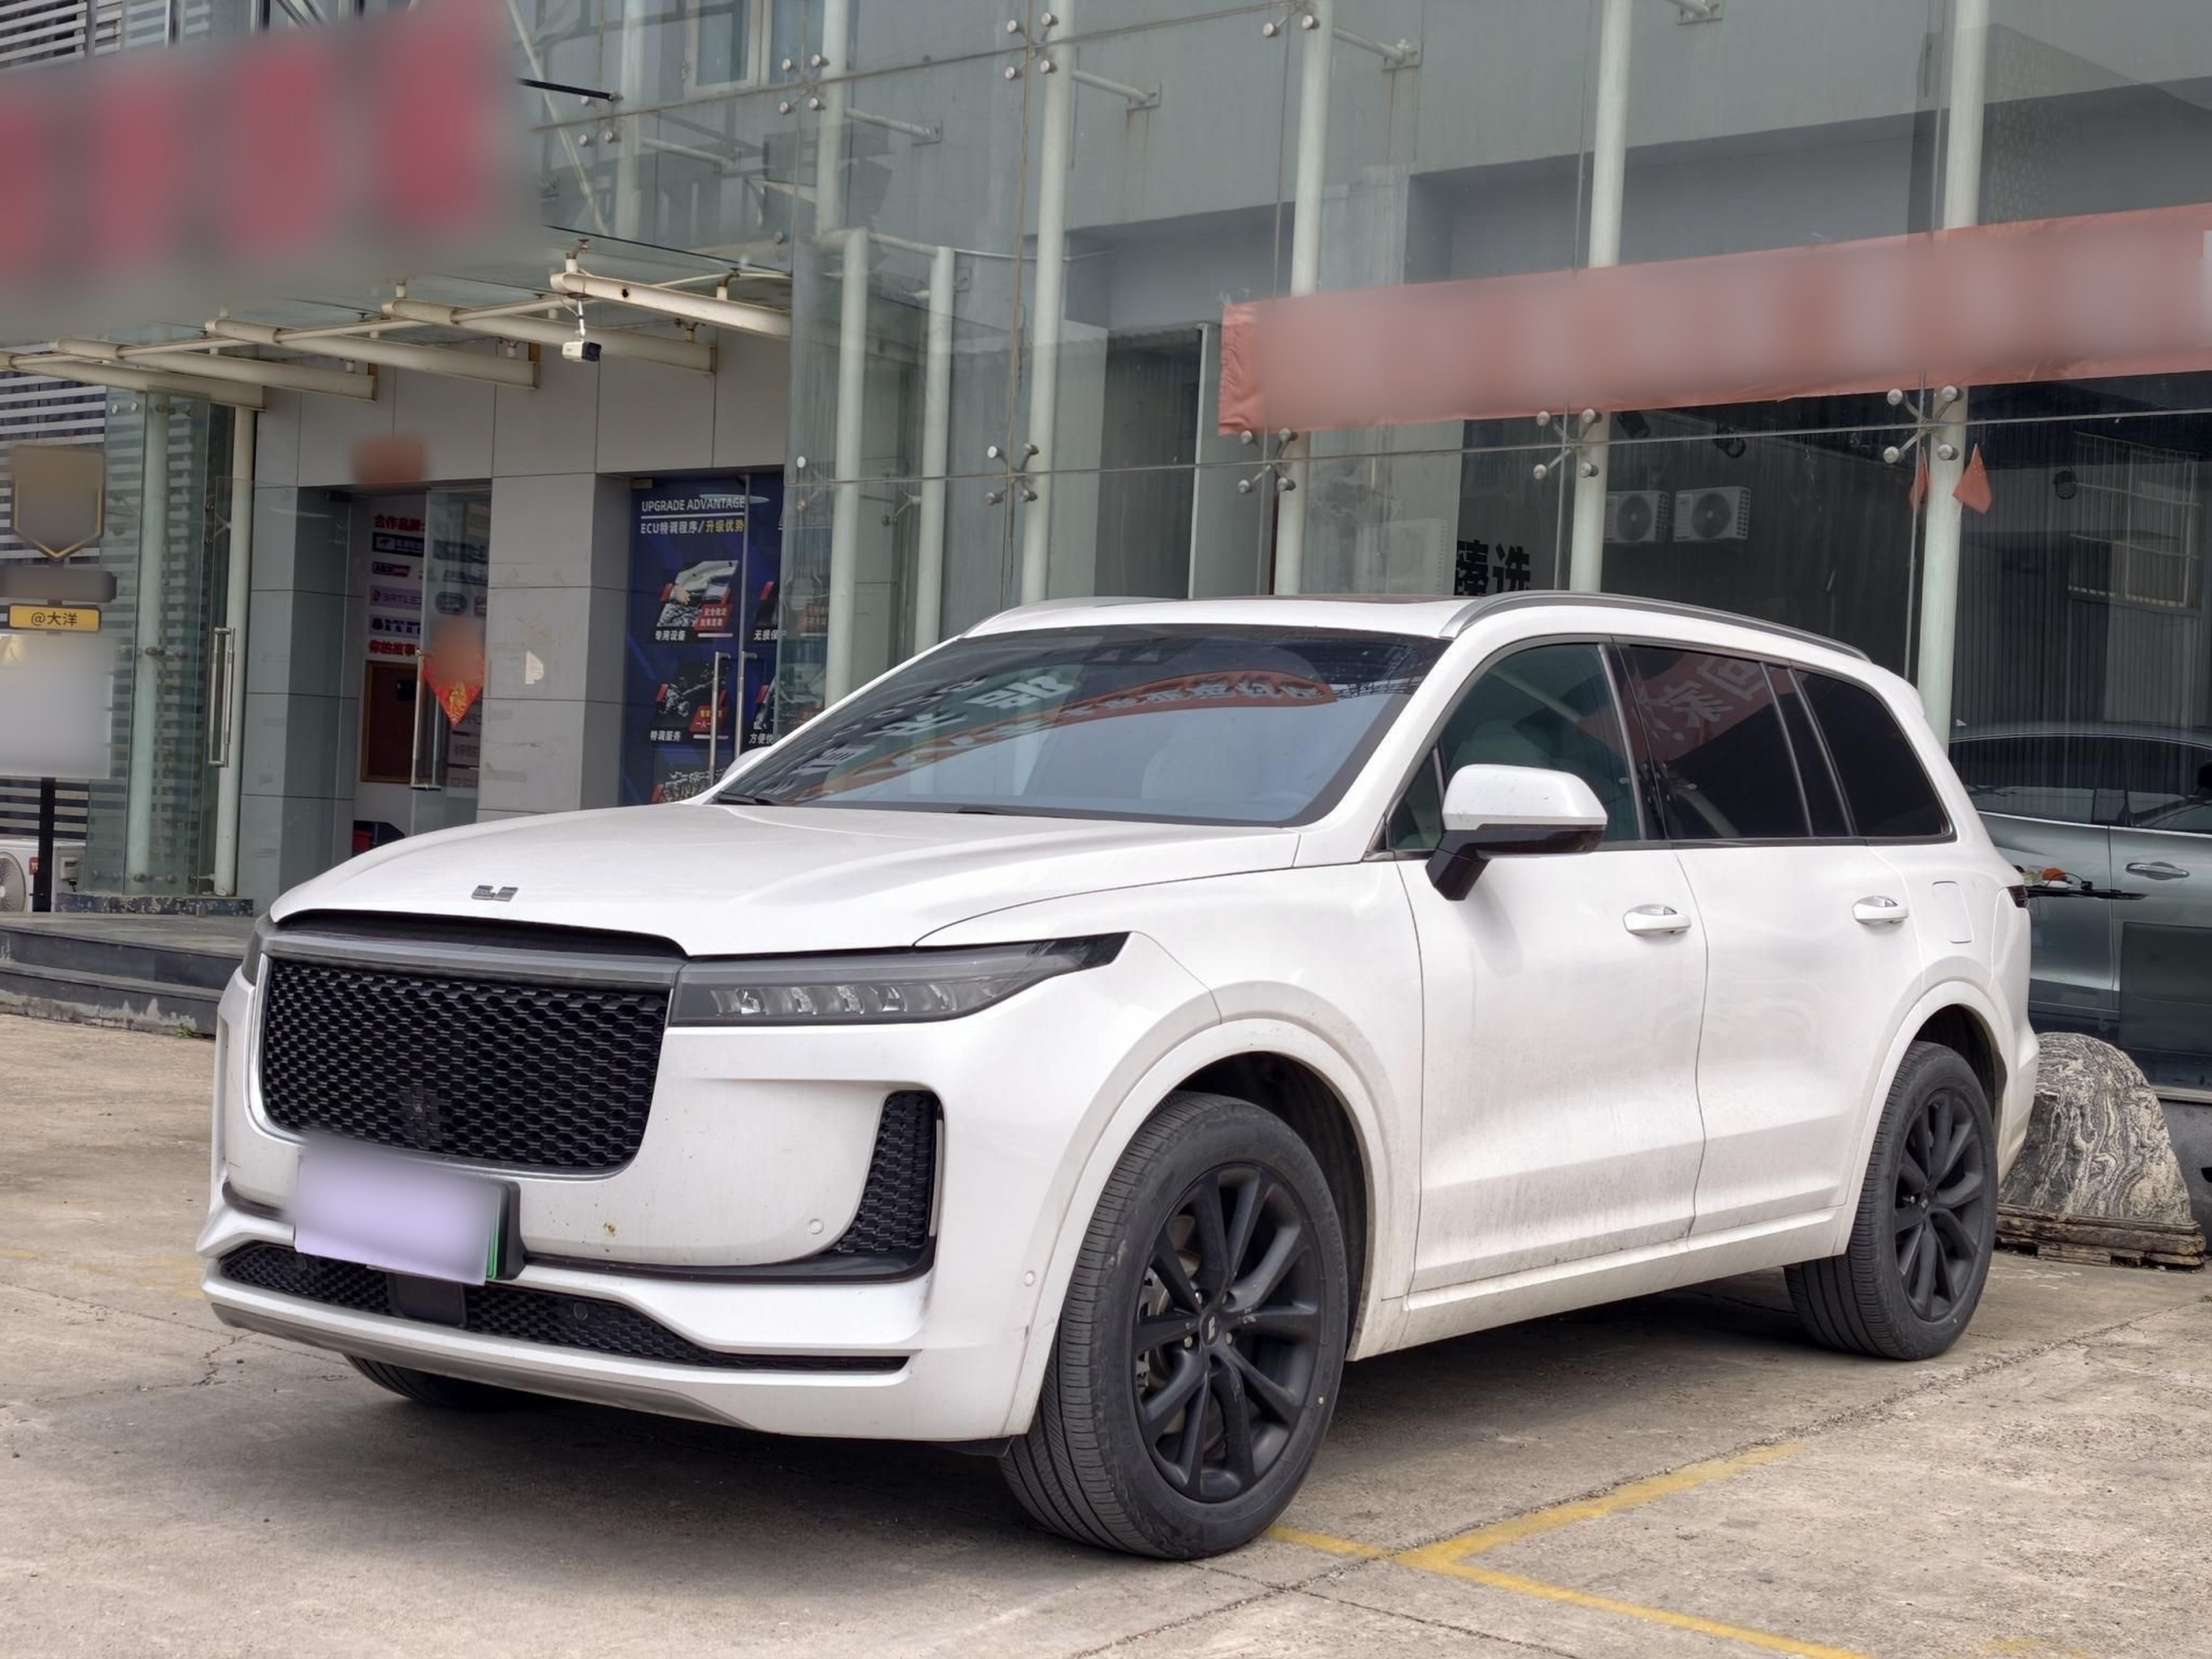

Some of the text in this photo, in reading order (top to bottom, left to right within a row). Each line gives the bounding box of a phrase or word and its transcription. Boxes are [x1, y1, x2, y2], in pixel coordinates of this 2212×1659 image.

[641, 497, 745, 512] UPGRADE ADVANTAGE
[31, 611, 78, 627] @大洋
